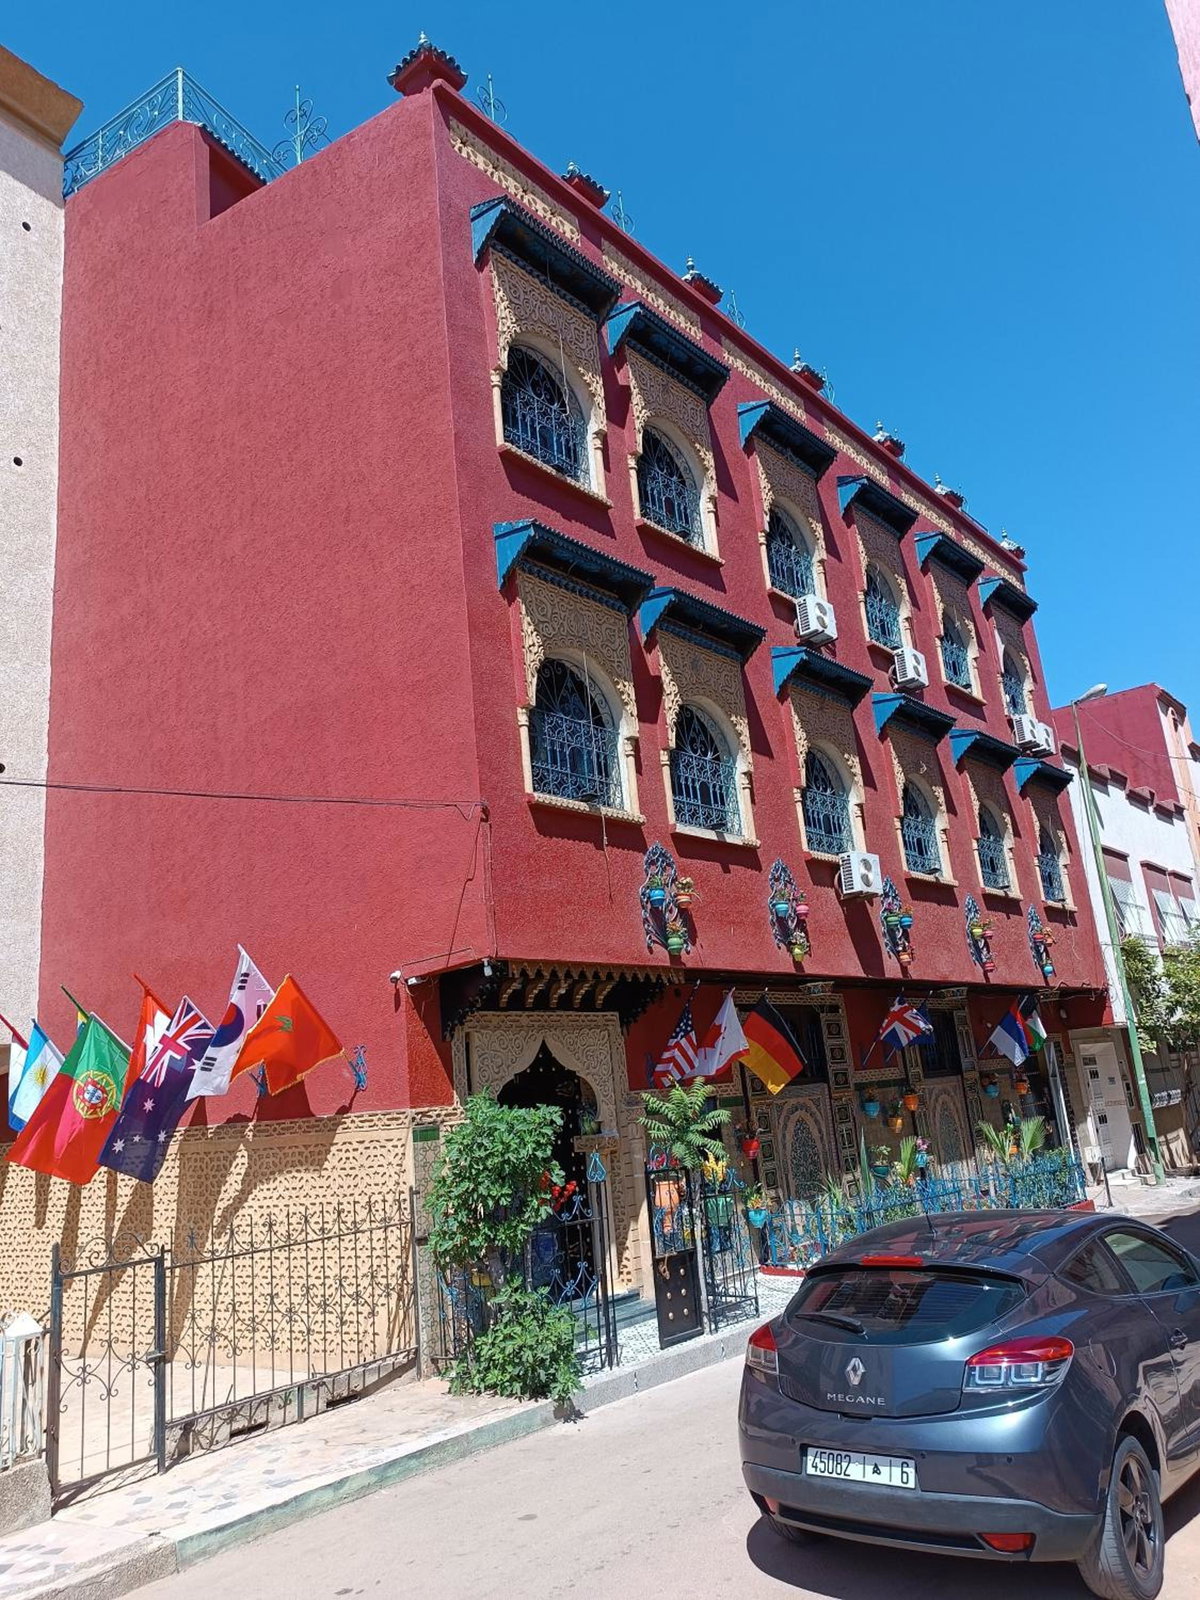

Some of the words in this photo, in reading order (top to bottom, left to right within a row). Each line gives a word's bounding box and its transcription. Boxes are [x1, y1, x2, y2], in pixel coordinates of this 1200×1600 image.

[827, 1392, 886, 1406] MEGANE
[811, 1450, 851, 1477] 45082
[900, 1461, 910, 1485] 6
